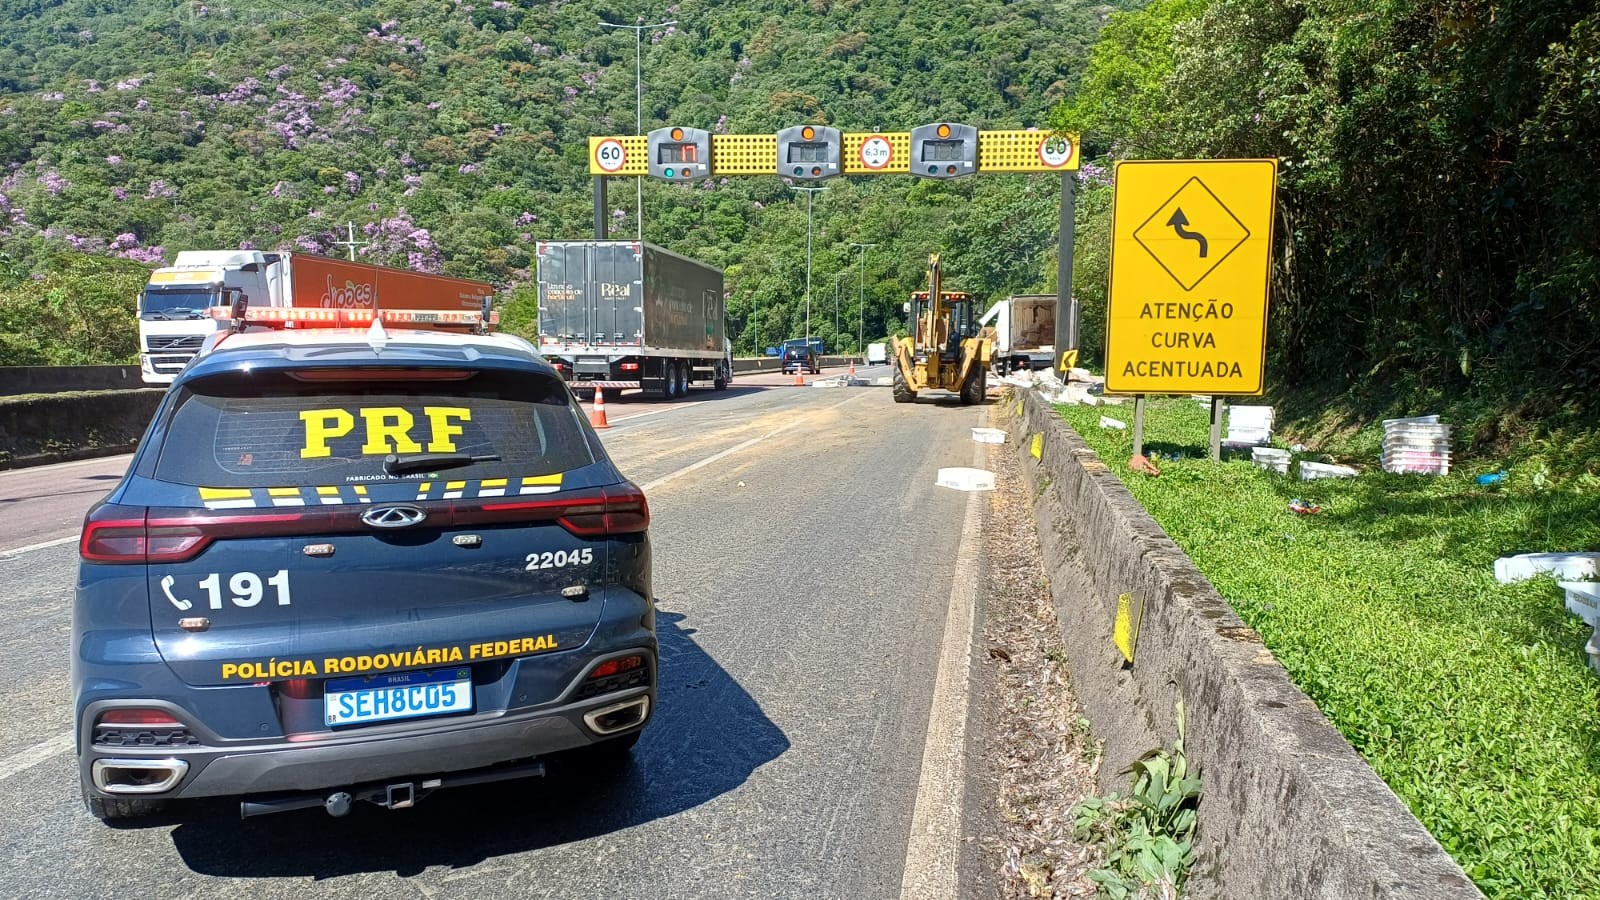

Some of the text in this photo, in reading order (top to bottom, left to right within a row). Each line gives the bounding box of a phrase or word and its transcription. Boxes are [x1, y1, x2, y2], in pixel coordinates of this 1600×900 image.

[601, 146, 620, 160] 60
[601, 283, 631, 297] Real
[1140, 299, 1233, 322] ATENÇÃO
[1151, 332, 1217, 349] CURVA
[1122, 361, 1243, 378] ACENTUADA
[299, 406, 472, 459] PRF
[346, 474, 386, 482] FABRICADO
[525, 547, 593, 571] 22045
[199, 569, 291, 610] 191
[222, 634, 558, 679] POLÍCIA RODOVIÁRIA FEDERAL
[387, 674, 411, 683] BRASIL
[338, 682, 456, 719] SEH8C05
